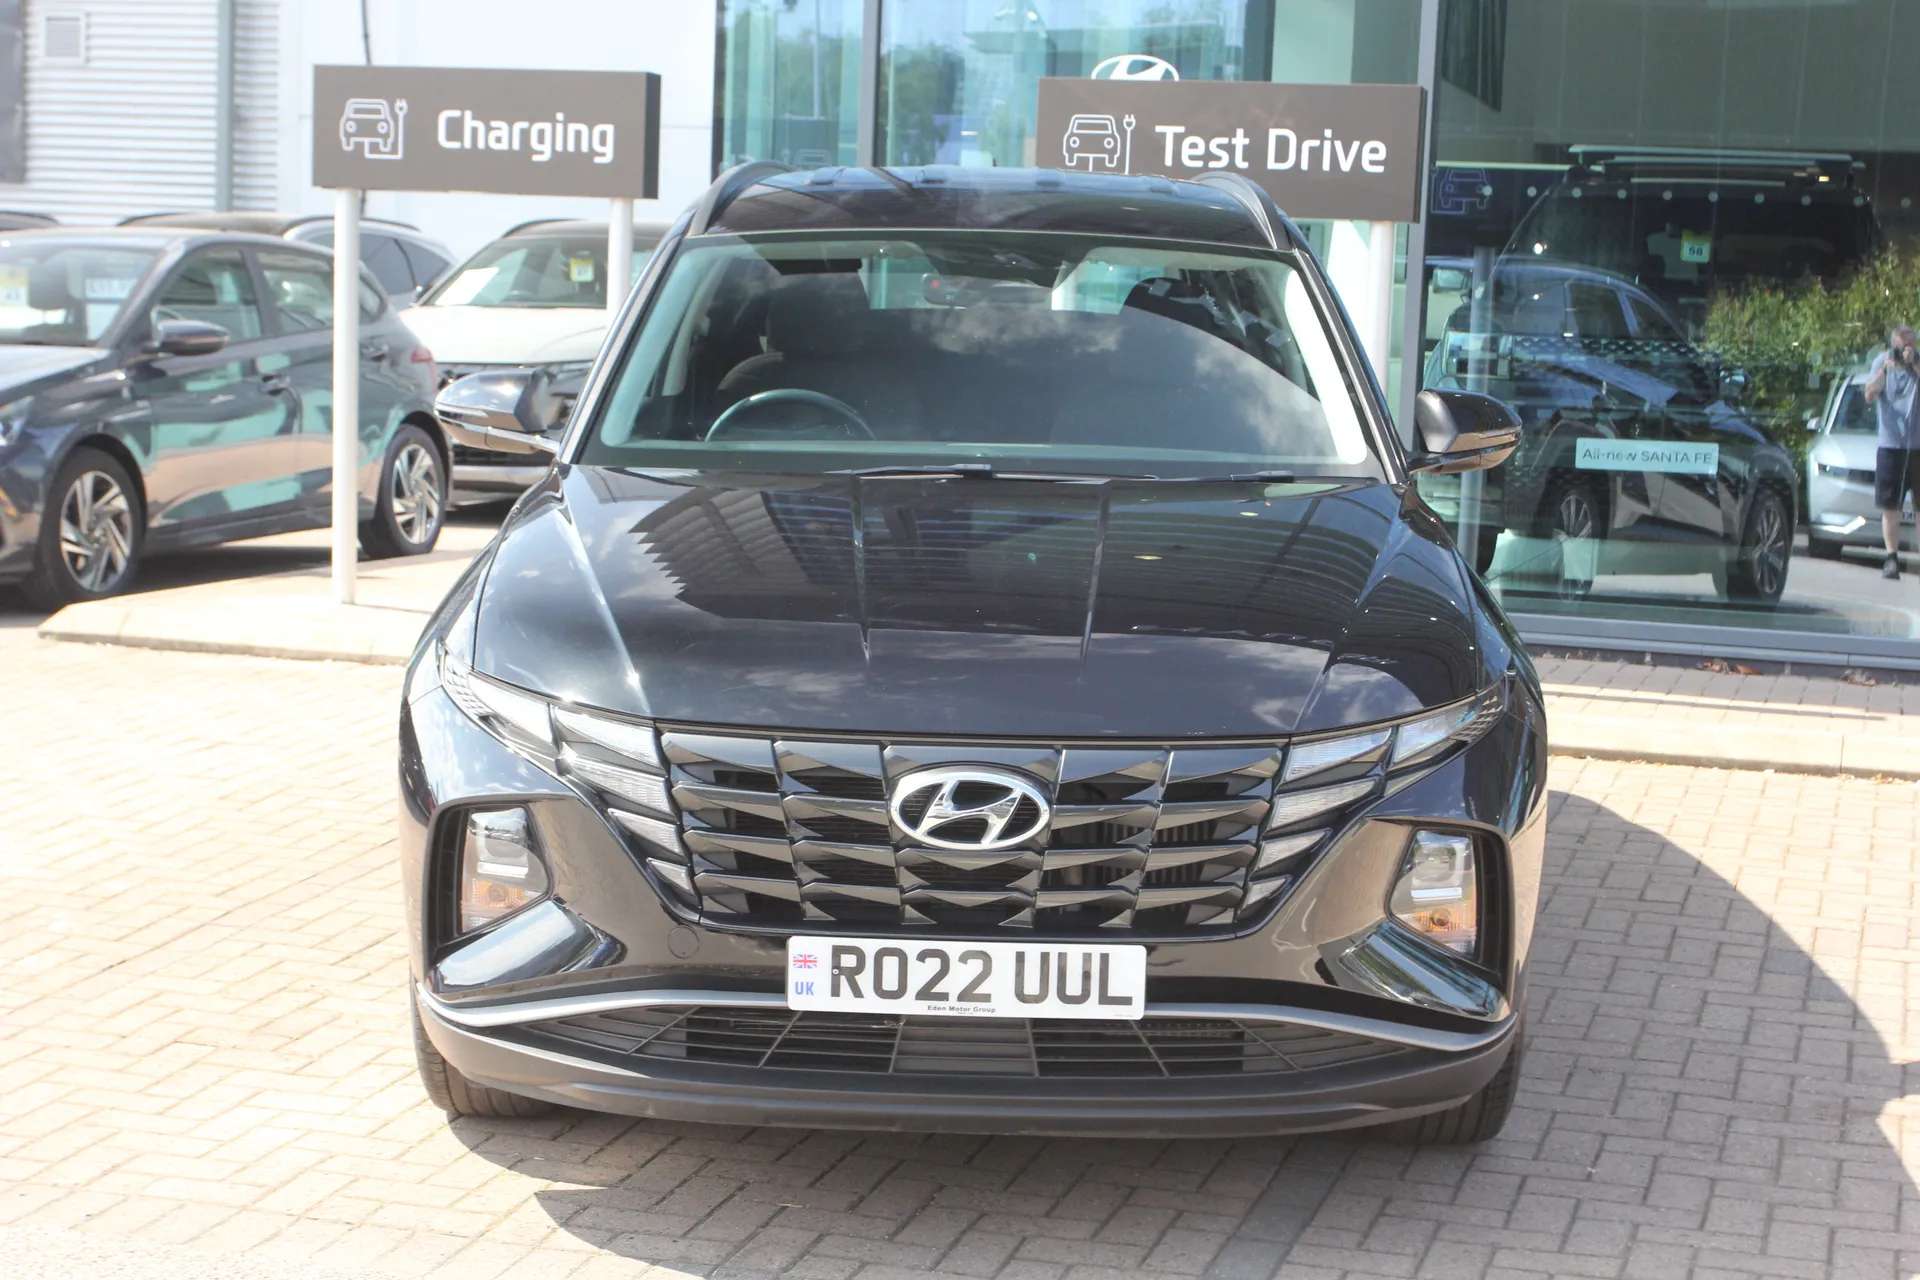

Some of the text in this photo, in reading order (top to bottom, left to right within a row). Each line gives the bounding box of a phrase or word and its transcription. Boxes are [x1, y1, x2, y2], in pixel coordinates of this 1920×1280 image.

[437, 109, 616, 164] Charging
[1154, 125, 1388, 173] Test Drive
[1640, 450, 1690, 463] SANTA
[1694, 452, 1712, 464] FE
[794, 981, 815, 996] UK
[830, 945, 1133, 1006] RO22 UUL
[973, 1006, 997, 1014] Group
